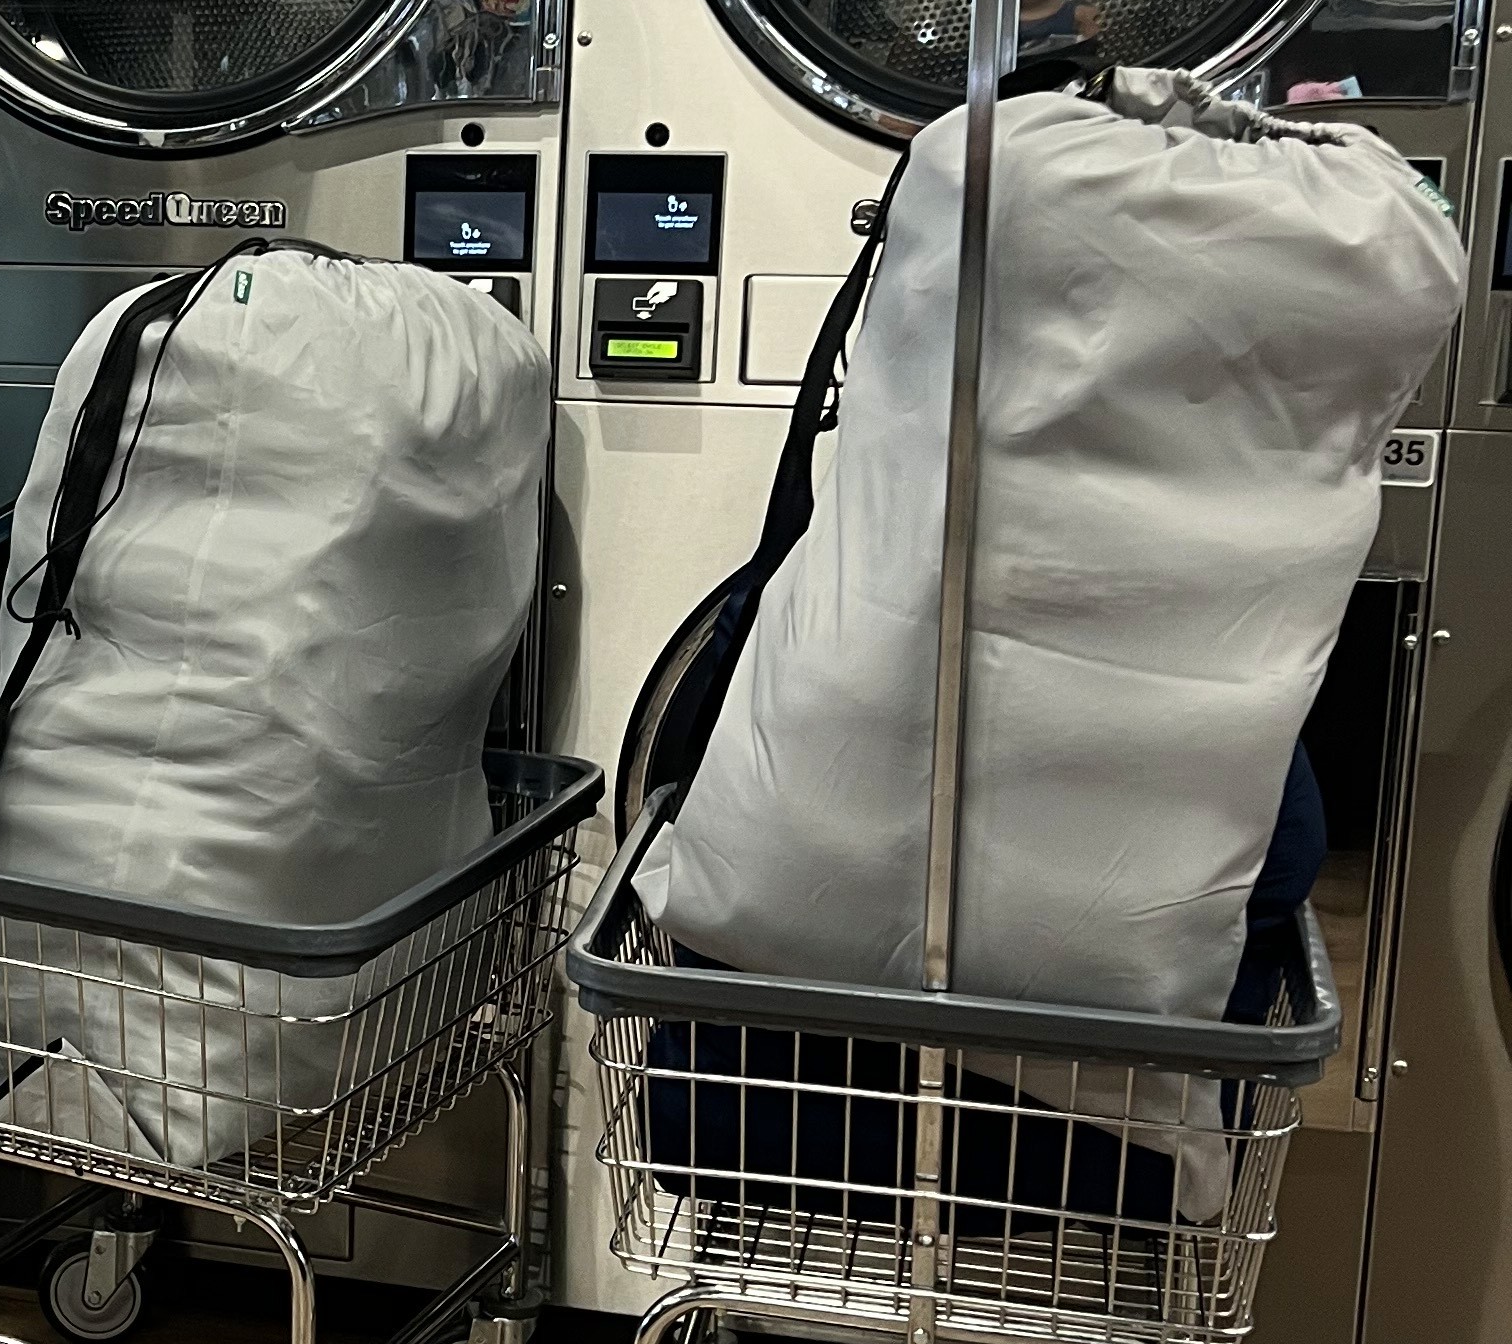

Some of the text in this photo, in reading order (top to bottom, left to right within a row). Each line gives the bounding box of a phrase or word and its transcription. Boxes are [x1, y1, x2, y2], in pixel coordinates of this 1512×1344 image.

[45, 191, 286, 231] Speed Queen
[1384, 439, 1425, 466] 35
